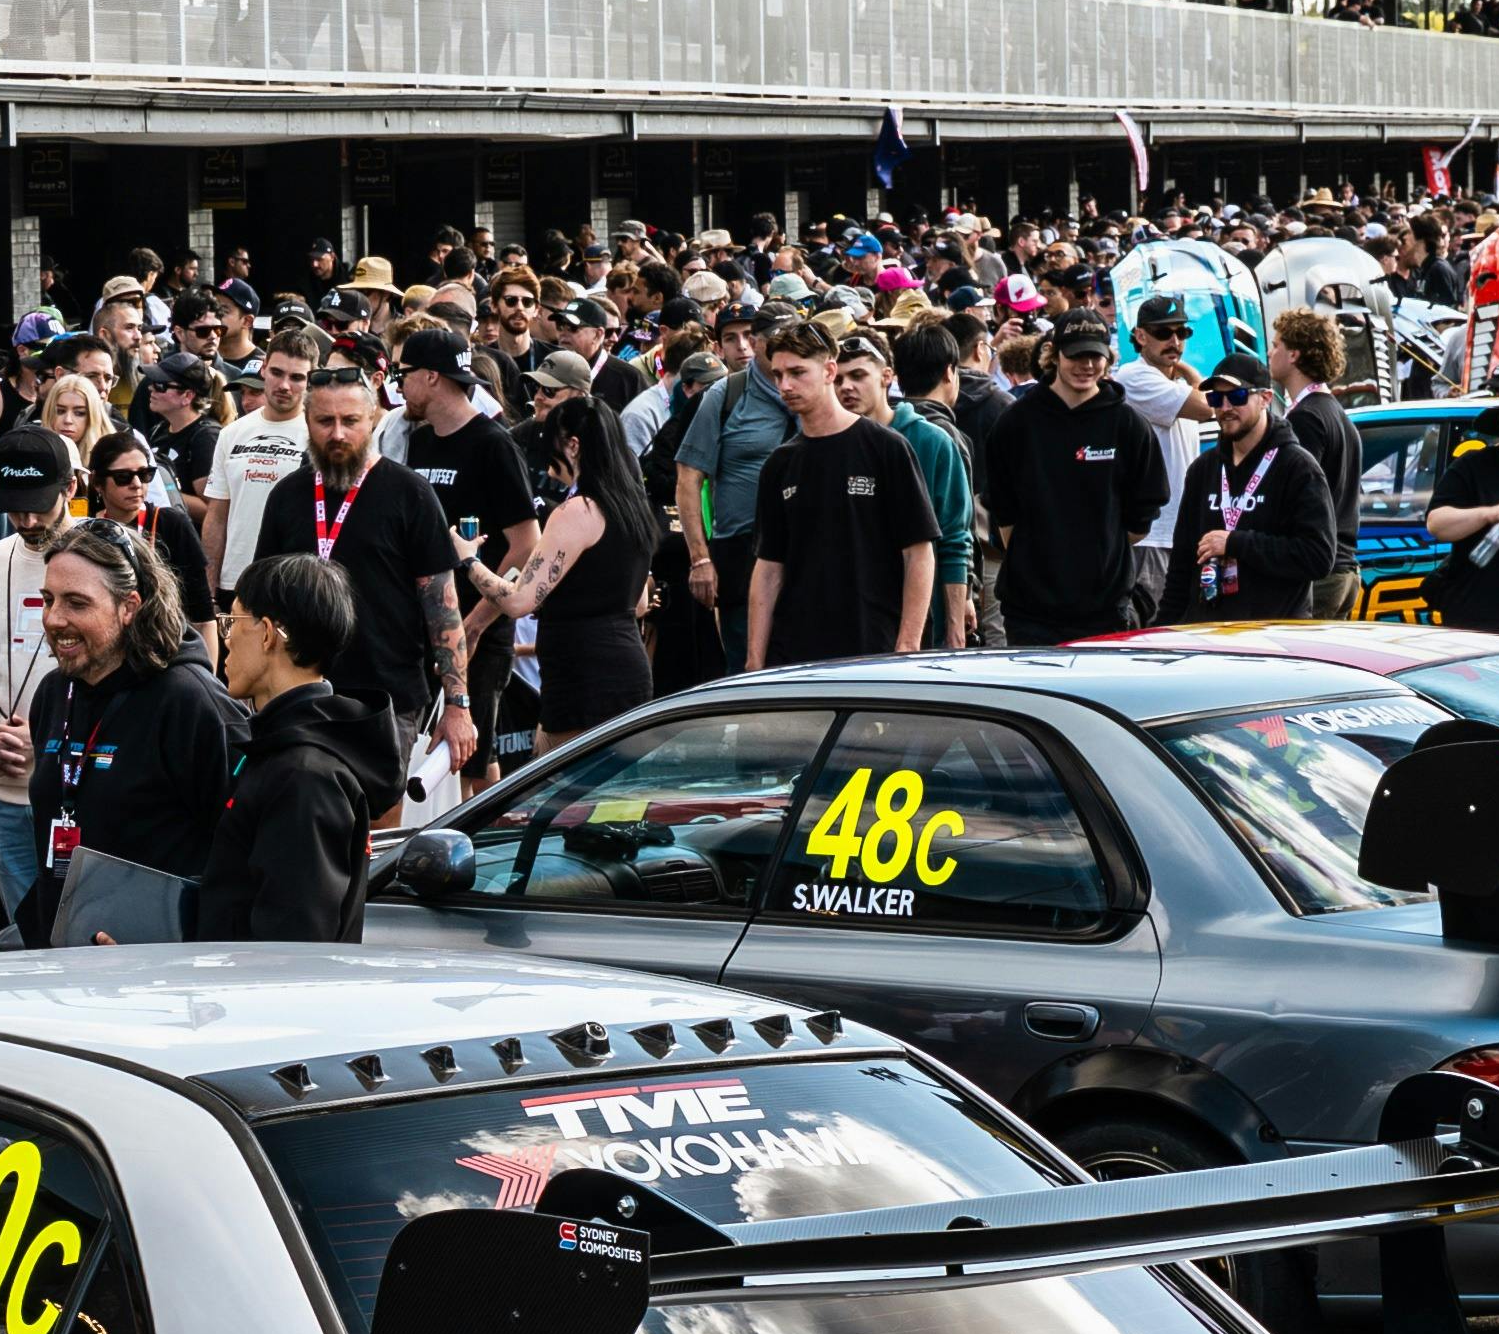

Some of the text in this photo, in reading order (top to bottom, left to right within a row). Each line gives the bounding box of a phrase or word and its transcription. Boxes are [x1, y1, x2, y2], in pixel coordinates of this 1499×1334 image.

[792, 884, 915, 918] S.WALKER
[525, 1088, 766, 1142] TME
[558, 1126, 876, 1186] YOKOHAMA
[578, 1227, 621, 1243] SYDNEY
[578, 1241, 643, 1265] COMPOSITES
